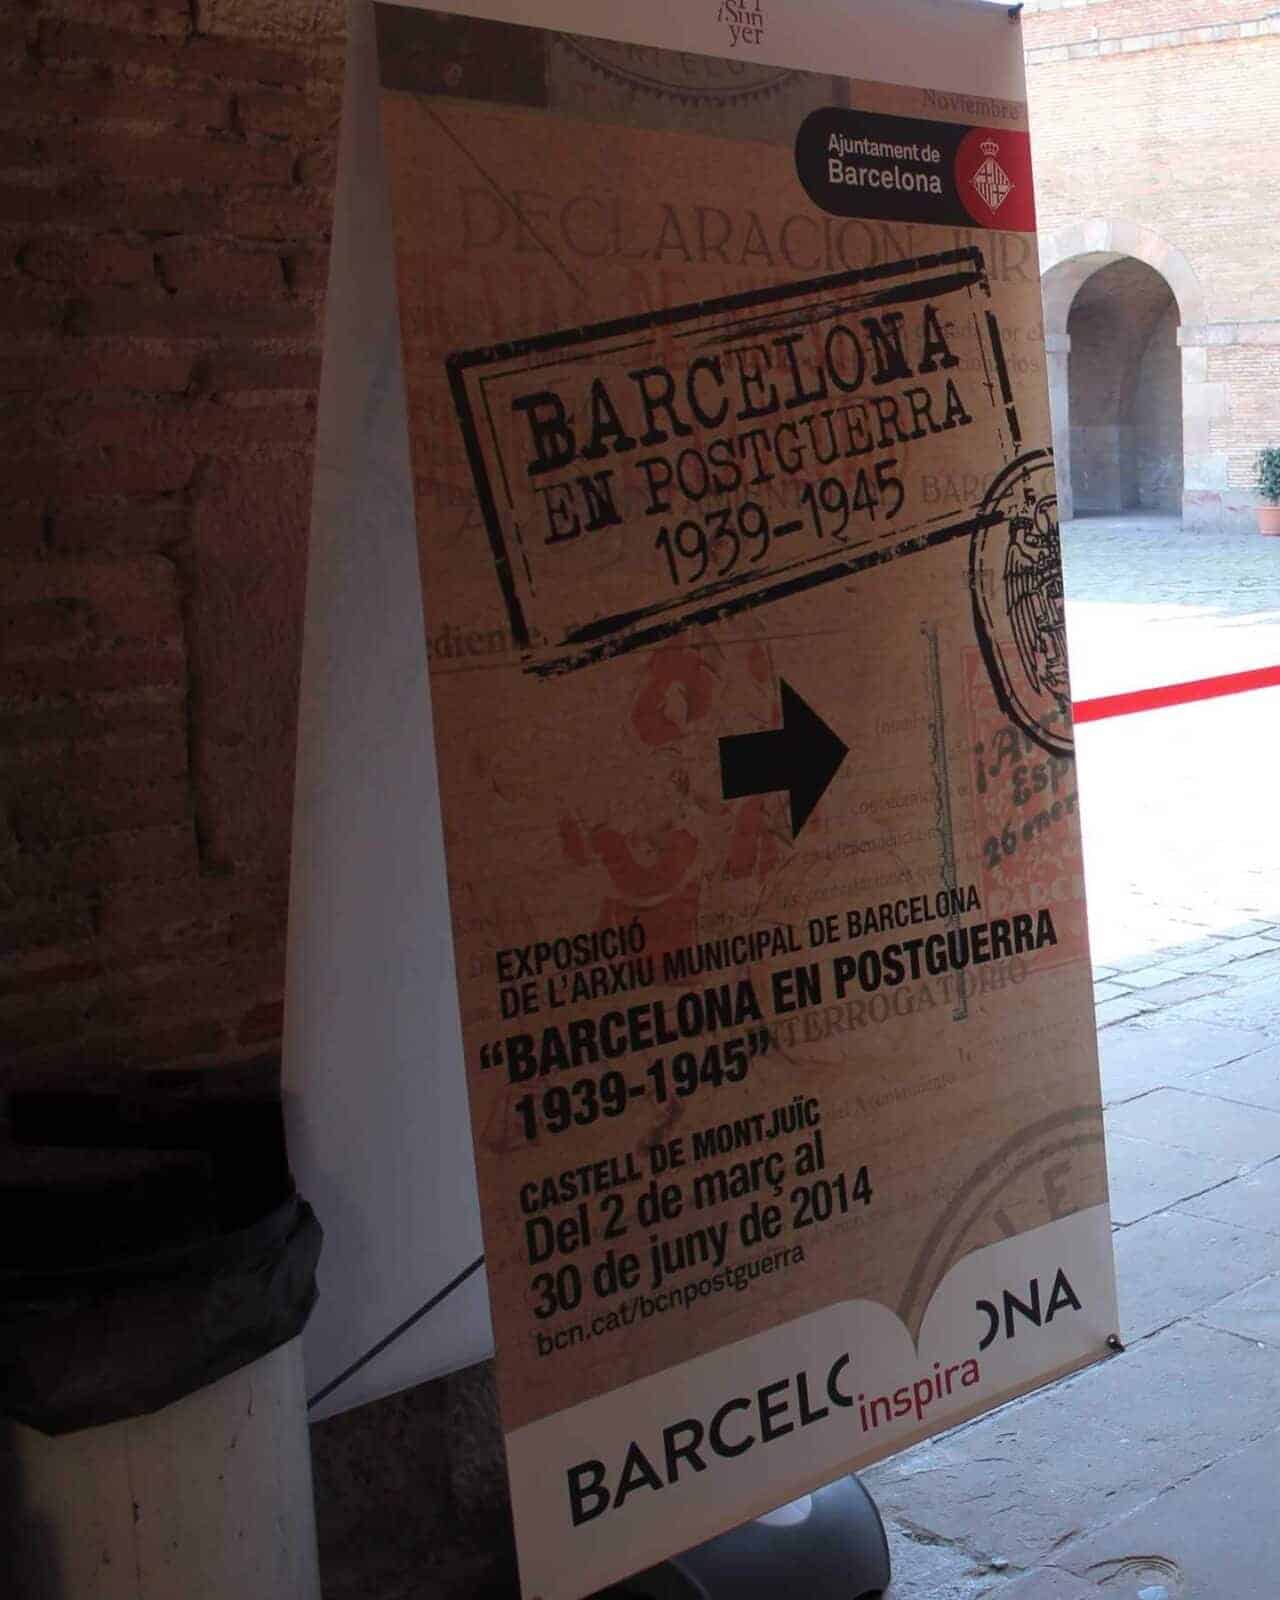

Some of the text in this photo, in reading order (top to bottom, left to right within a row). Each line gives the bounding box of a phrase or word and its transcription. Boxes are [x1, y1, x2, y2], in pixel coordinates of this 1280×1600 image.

[727, 23, 765, 48] yer
[827, 133, 942, 163] Ajuntament de
[920, 86, 1026, 121] Noviembre
[827, 157, 943, 194] Barcelona
[512, 304, 960, 477] BARCELONA
[534, 378, 973, 545] EN POSTGUERRA
[496, 915, 647, 984] EXPOSICIÓ
[500, 982, 543, 1020] DE
[663, 922, 801, 982] MUNICIPAL
[809, 912, 840, 949] DE
[848, 884, 981, 939] BARCELONA
[772, 960, 822, 1014] EN
[834, 908, 1058, 998] POSTGUERRA
[520, 1151, 643, 1214] CASTELL
[650, 1138, 685, 1175] DE
[692, 1095, 821, 1162] MONTJUÏC
[525, 1130, 826, 1266] Del 2 de març al
[530, 1164, 873, 1320] 30 de juny de 2014
[536, 1244, 805, 1357] bcn.cat/bcnpostguerra
[859, 1355, 981, 1433] inspira
